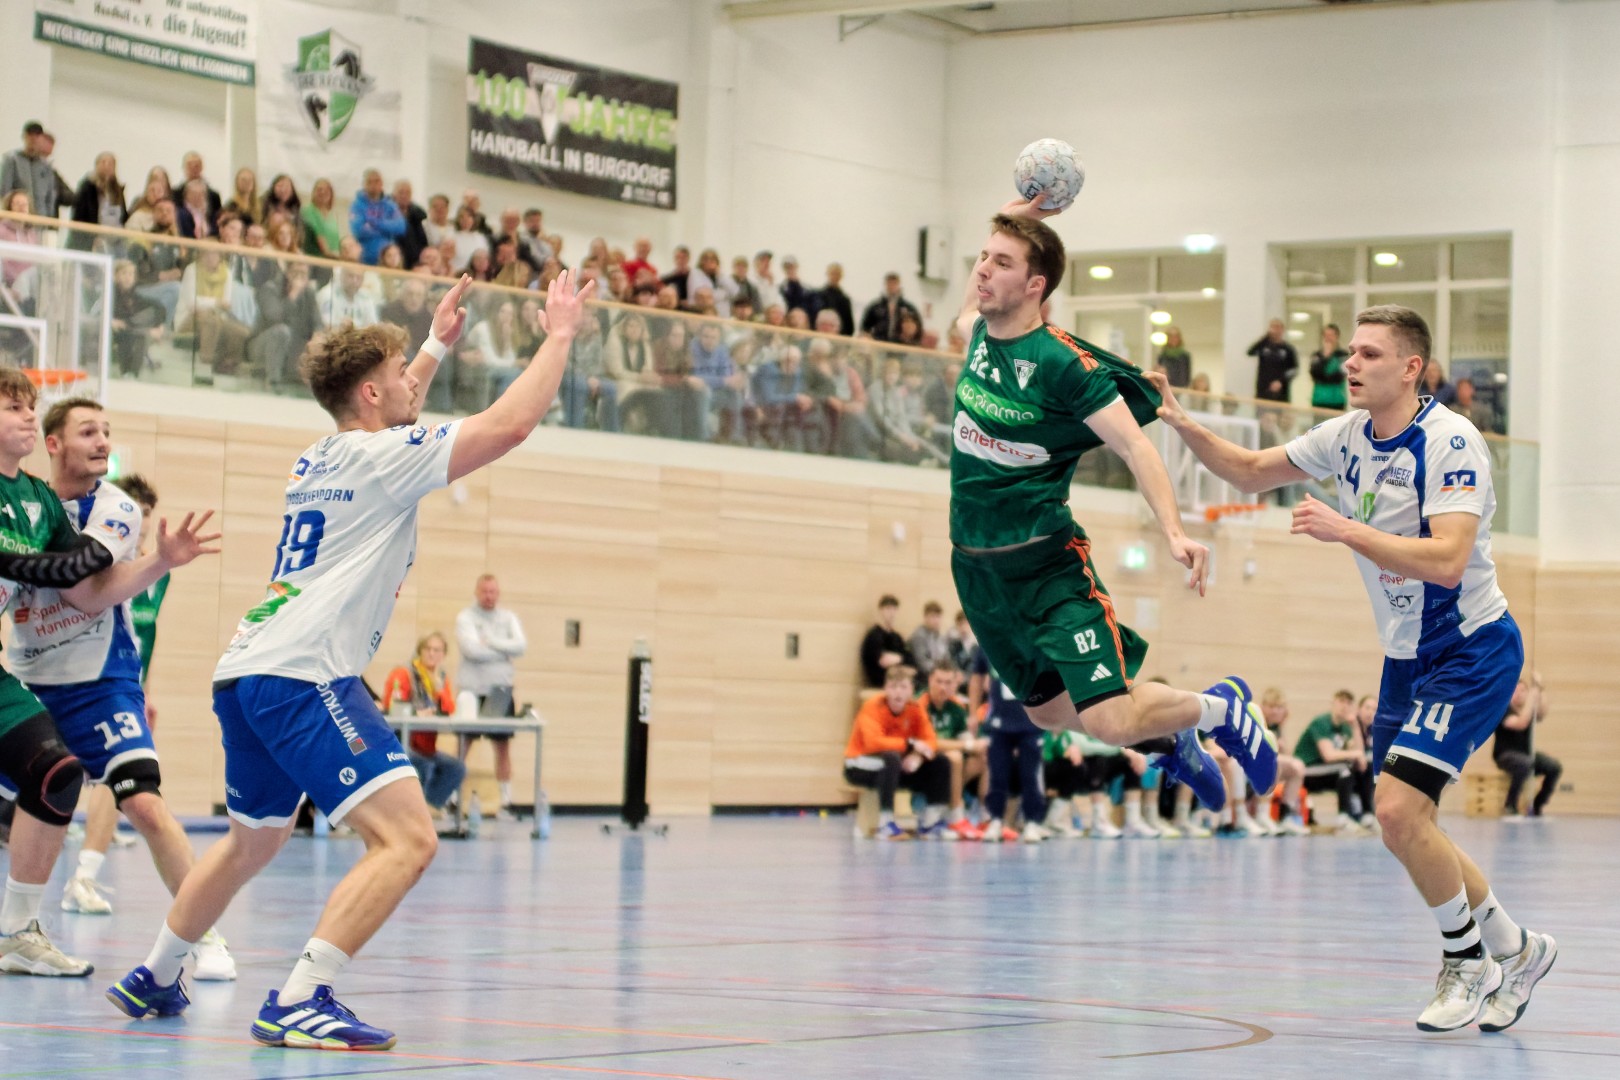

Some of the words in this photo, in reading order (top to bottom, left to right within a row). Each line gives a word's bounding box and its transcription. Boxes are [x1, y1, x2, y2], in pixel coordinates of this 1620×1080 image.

[163, 14, 187, 34] die
[474, 68, 526, 121] 100
[568, 91, 675, 153] JAHRE
[470, 128, 561, 168] HANDBALL
[564, 148, 581, 173] IN
[583, 152, 671, 188] BURGDORF
[271, 509, 326, 582] 19
[1073, 628, 1101, 654] 82
[93, 711, 143, 751] 13
[1401, 699, 1455, 742] 14
[386, 752, 409, 763] Kemp
